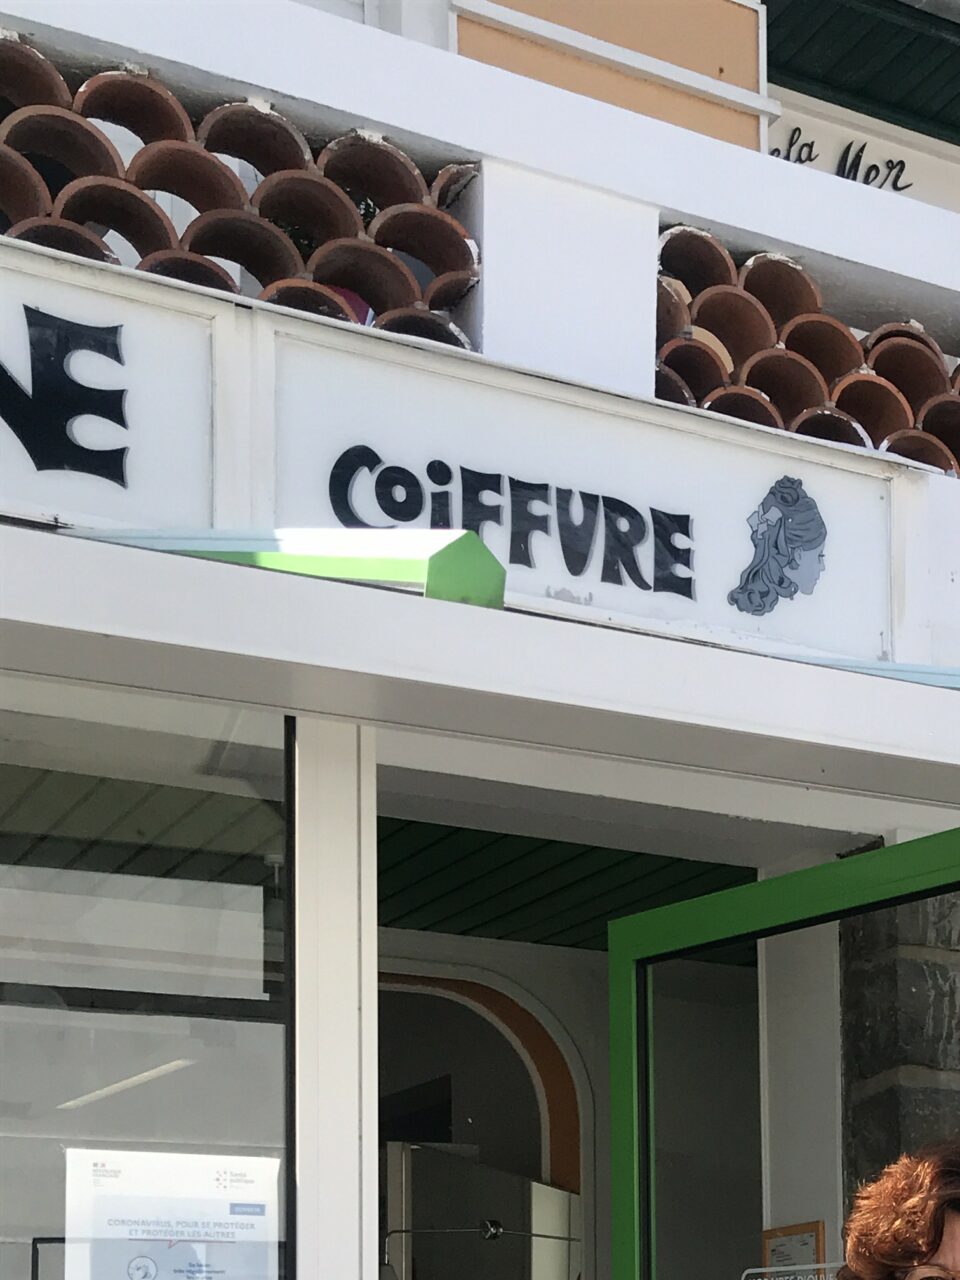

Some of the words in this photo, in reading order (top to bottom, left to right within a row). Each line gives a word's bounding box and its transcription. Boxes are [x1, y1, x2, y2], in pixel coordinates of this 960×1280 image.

[175, 1220, 200, 1229] POUR
[201, 1221, 211, 1229] SE
[129, 1229, 139, 1237] ET
[203, 1231, 236, 1239] AUTRES
